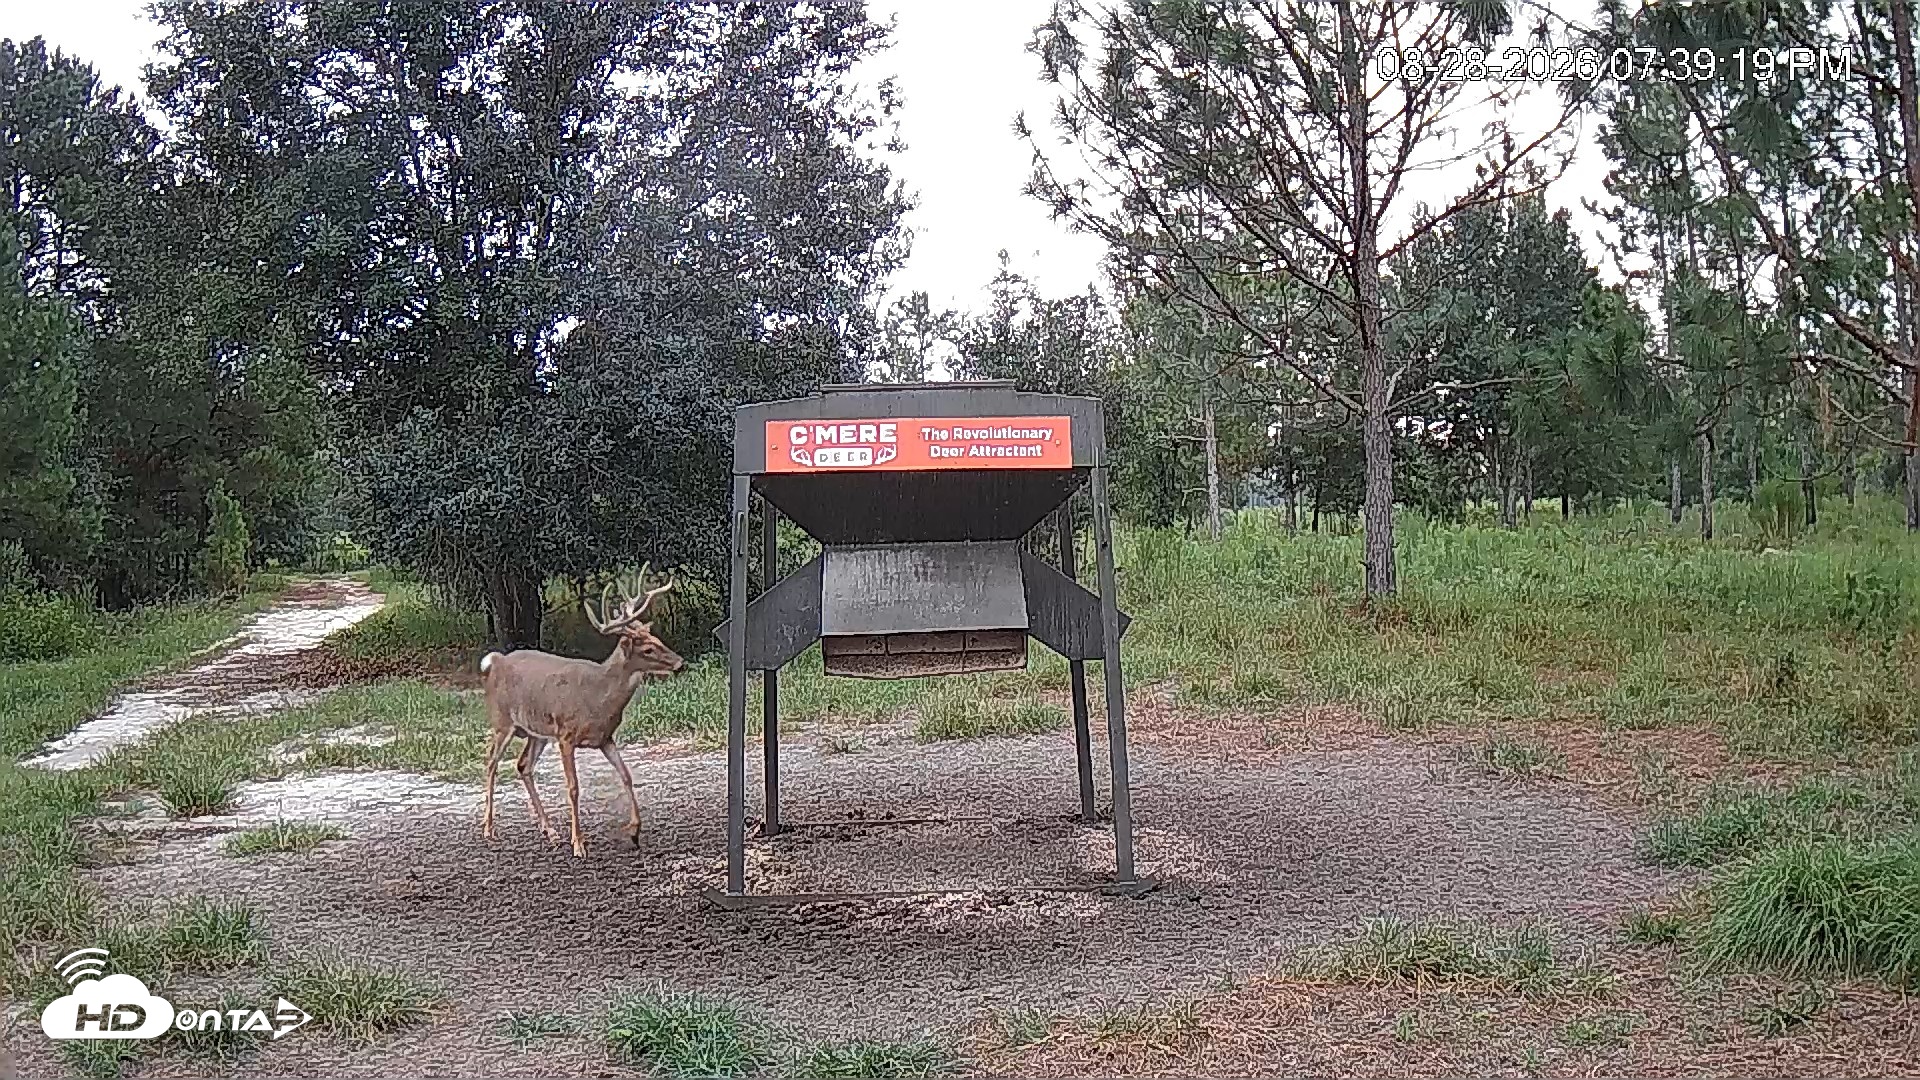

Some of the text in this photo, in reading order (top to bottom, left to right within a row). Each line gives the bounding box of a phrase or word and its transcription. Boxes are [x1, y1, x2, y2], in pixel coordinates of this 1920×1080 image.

[790, 424, 897, 445] C'MERE
[921, 426, 1053, 441] The Revolutionary
[819, 452, 867, 462] DEER
[930, 444, 1042, 457] Deer Attractant
